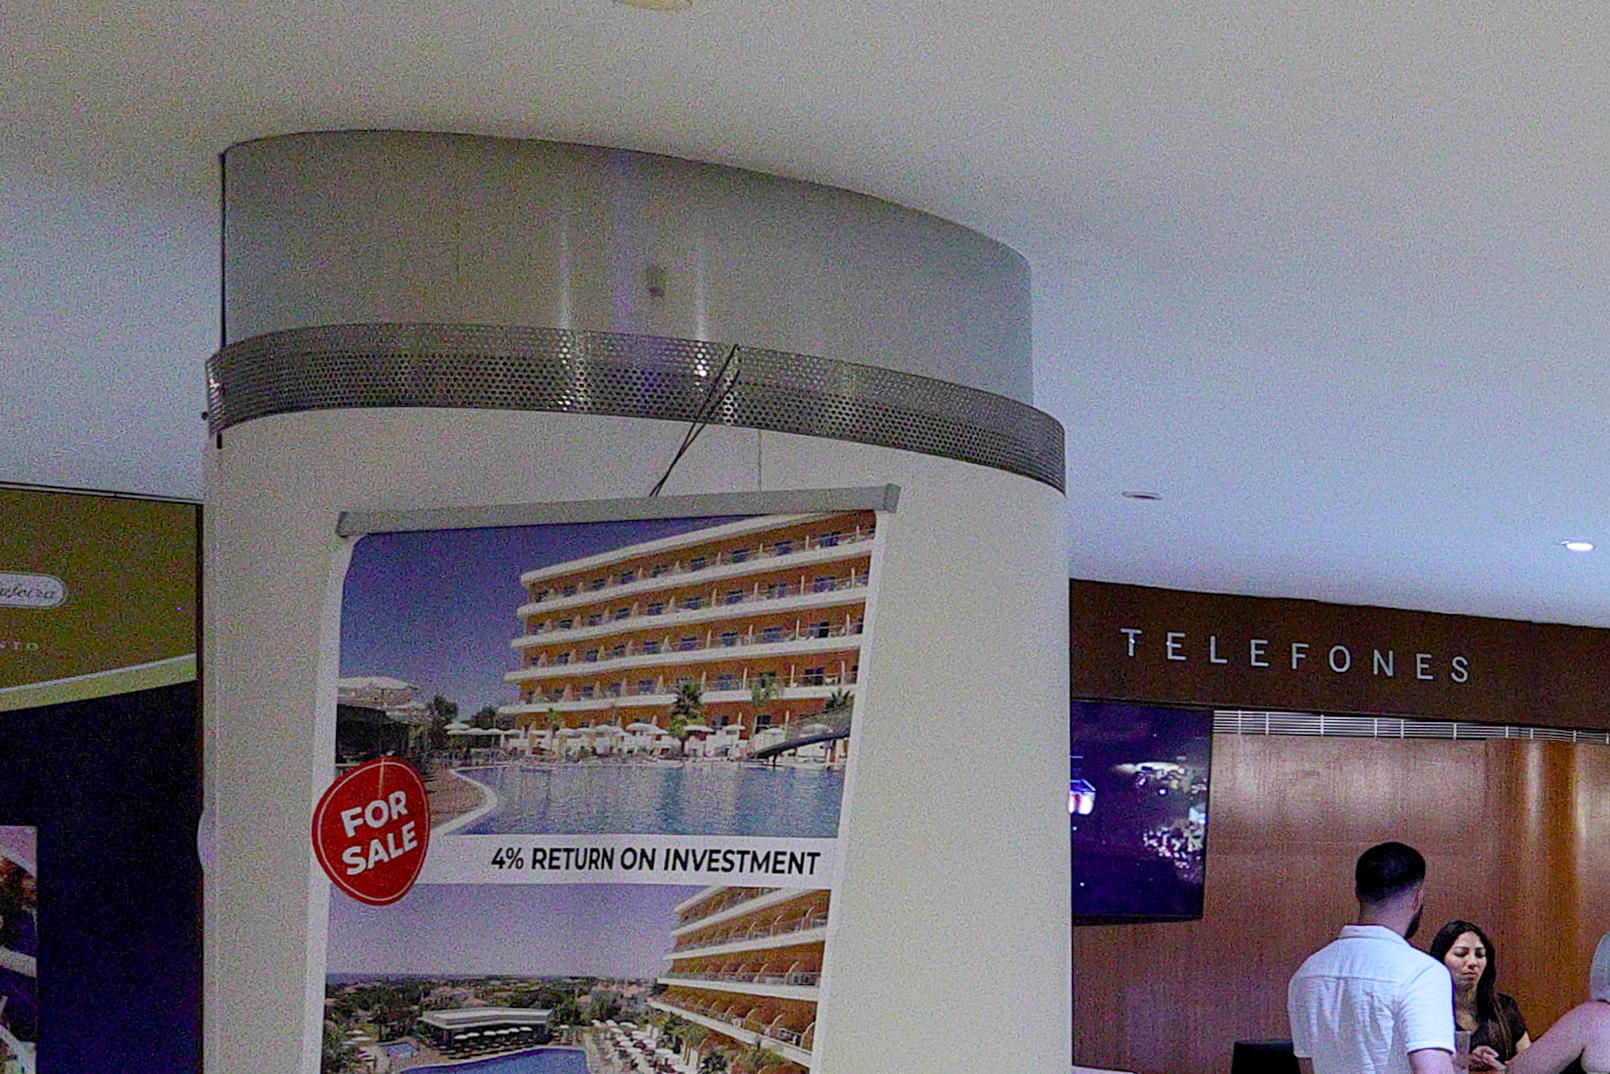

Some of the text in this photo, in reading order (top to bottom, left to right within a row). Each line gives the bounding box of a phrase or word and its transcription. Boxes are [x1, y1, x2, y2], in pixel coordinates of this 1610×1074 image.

[1120, 628, 1469, 683] TELEFONES
[341, 791, 408, 838] FOR
[342, 820, 418, 876] SALE
[491, 847, 821, 875] 4% RETURN ON INVESTMENT
